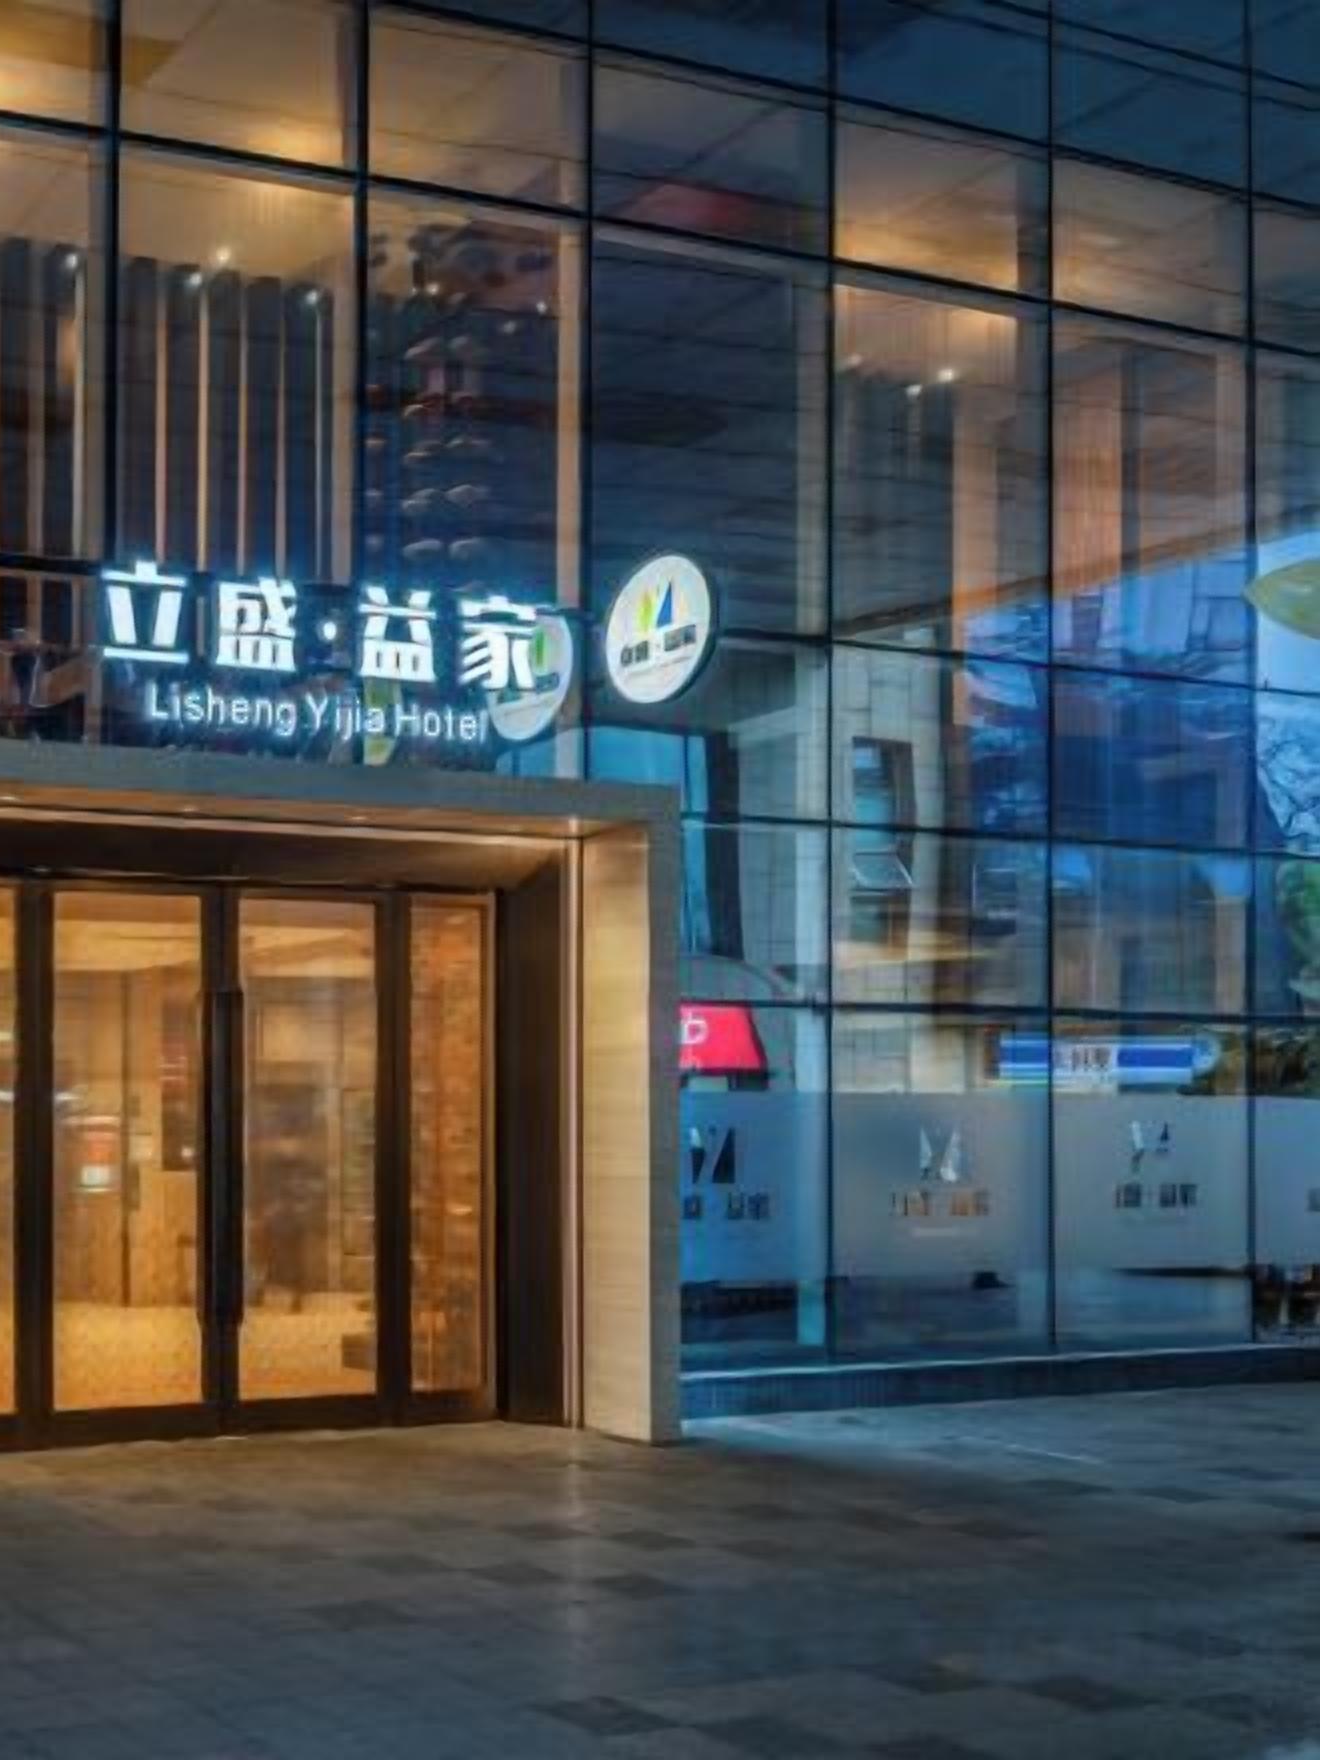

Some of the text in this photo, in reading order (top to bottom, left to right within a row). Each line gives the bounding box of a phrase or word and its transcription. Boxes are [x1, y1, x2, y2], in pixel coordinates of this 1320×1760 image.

[150, 681, 487, 743] Lisheng Yijia Hotel
